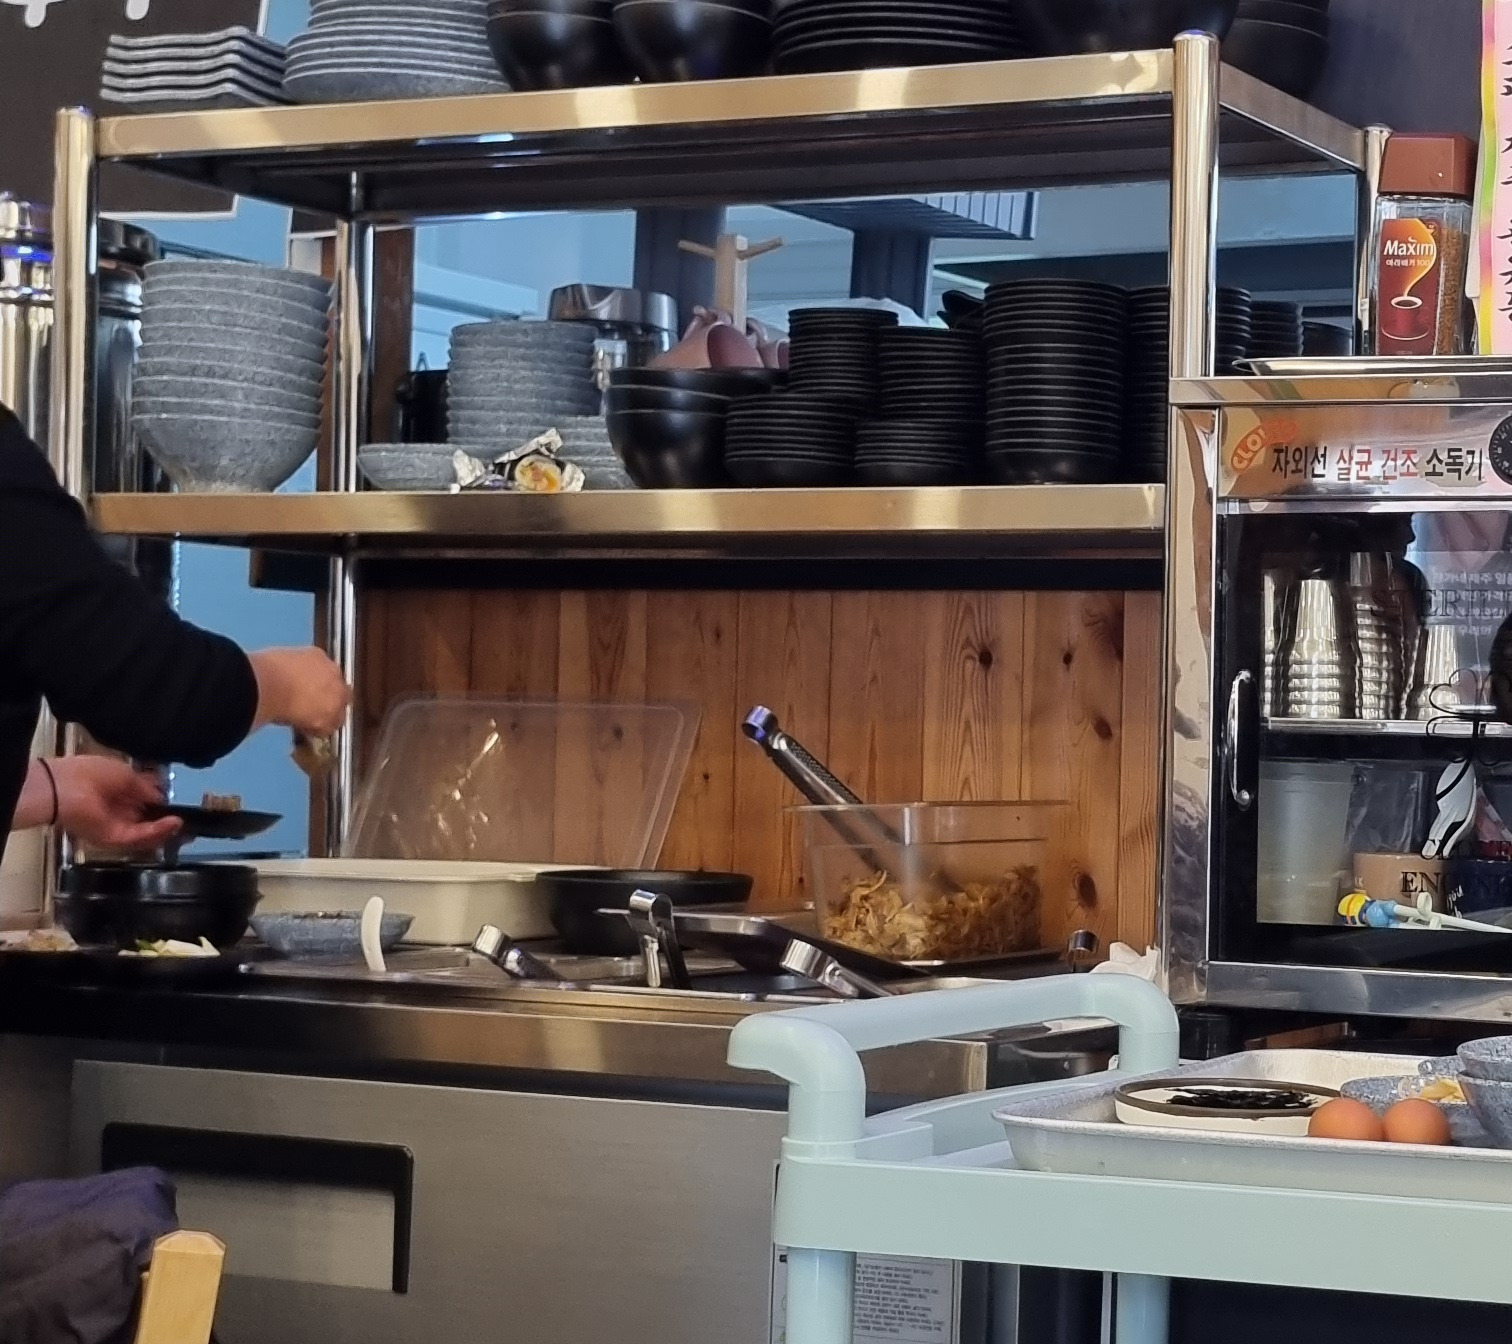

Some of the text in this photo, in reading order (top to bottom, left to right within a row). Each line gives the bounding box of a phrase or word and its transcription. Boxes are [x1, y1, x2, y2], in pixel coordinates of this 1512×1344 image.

[1384, 237, 1435, 256] Maxim
[1271, 446, 1483, 481] 자외선 살균 건조 소독기
